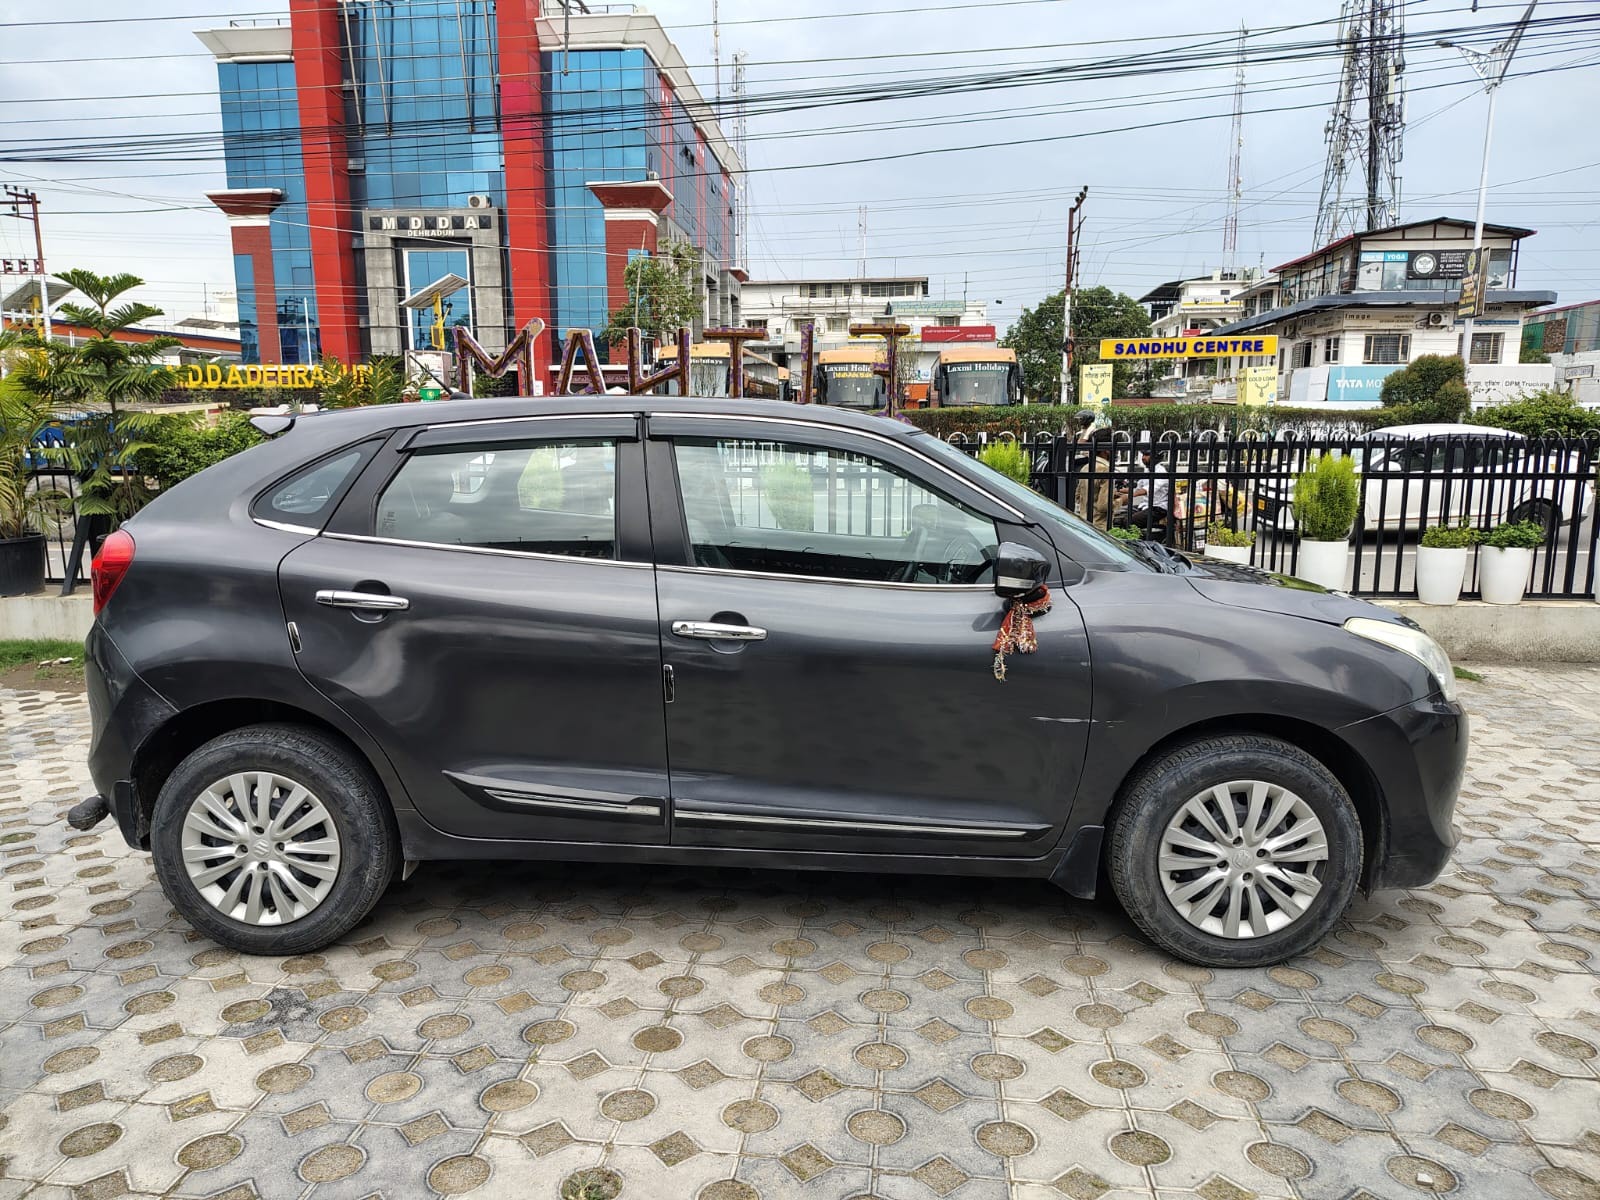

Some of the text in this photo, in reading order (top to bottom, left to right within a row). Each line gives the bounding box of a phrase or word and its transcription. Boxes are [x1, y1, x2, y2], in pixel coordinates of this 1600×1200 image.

[407, 229, 455, 237] DEHRADUN
[1114, 340, 1264, 355] SANDHU CENTRE
[947, 363, 1010, 373] Laxmi Holidays
[1336, 380, 1363, 388] TATA
